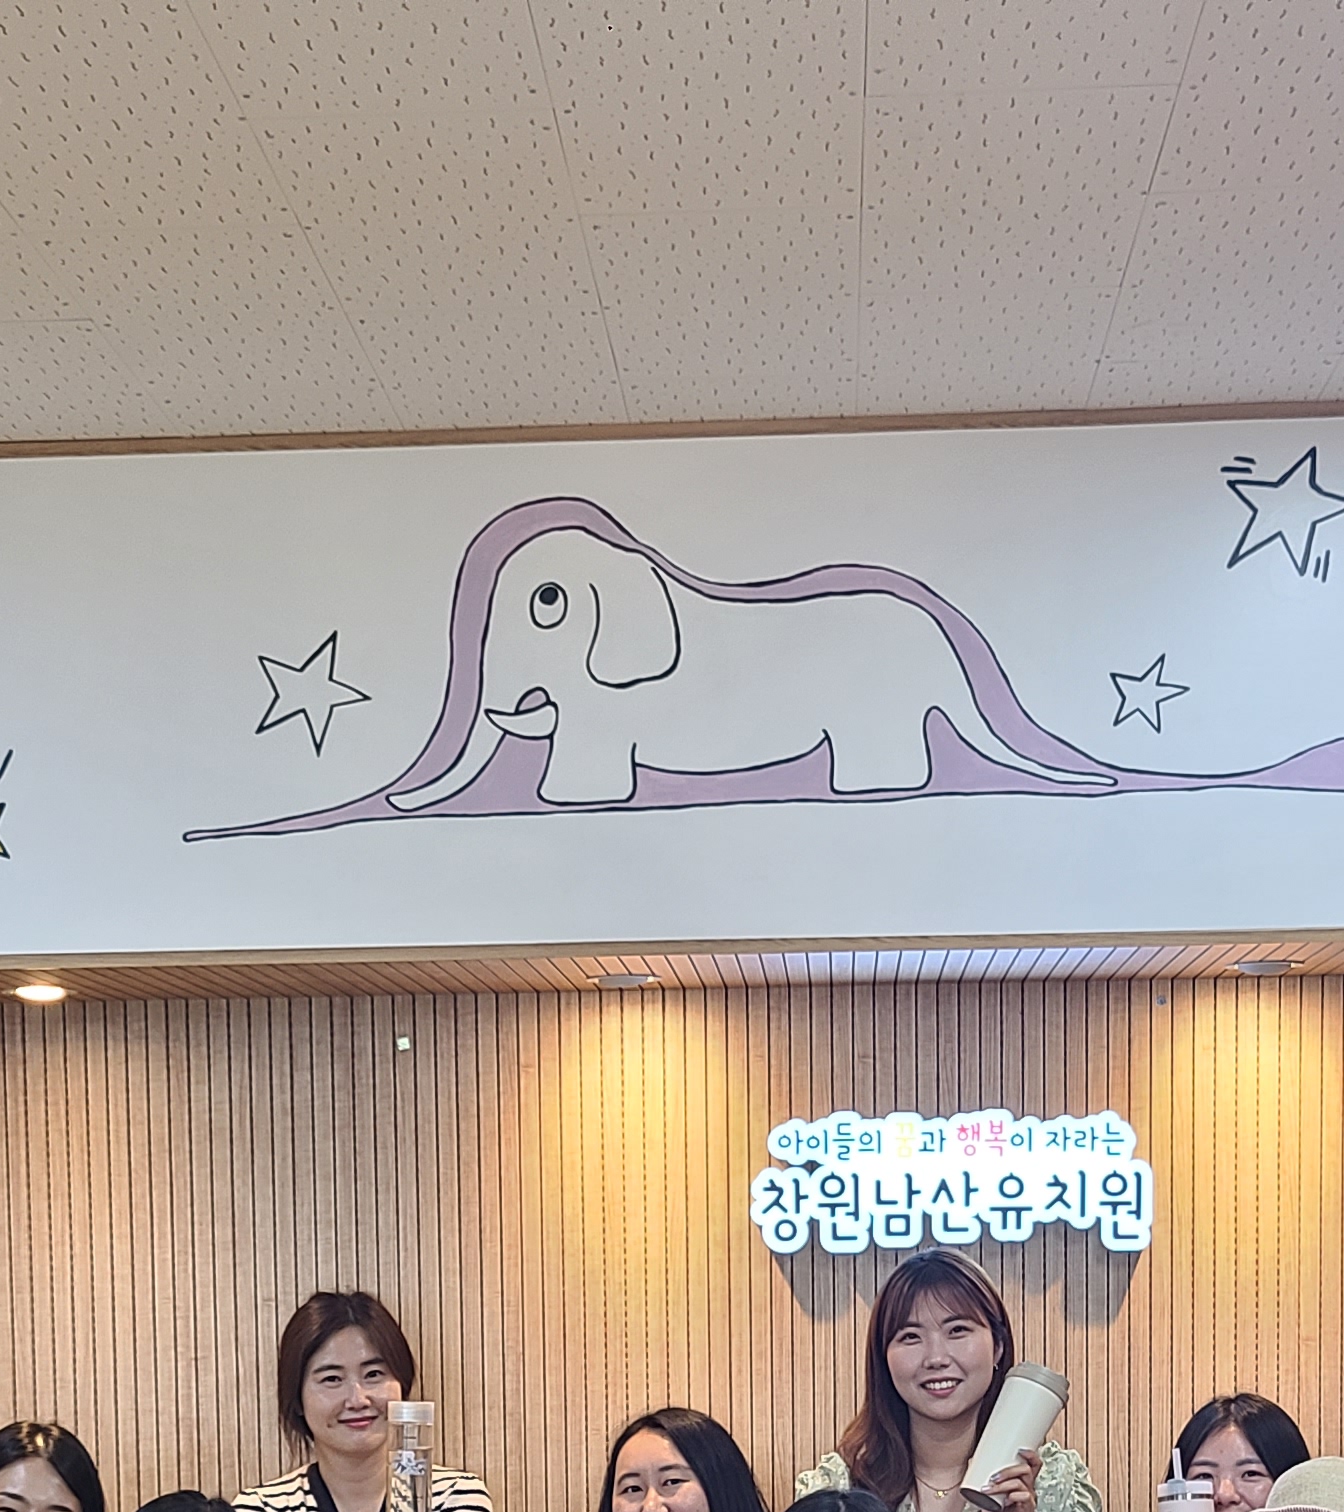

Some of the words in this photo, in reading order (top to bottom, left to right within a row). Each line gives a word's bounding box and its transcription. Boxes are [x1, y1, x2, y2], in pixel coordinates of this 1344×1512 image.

[777, 1121, 882, 1160] 아이들의
[895, 1121, 946, 1158] 꿈과
[956, 1119, 1033, 1158] 행복이
[1045, 1121, 1126, 1157] 자라는
[761, 1170, 1143, 1242] 창원남산유치원
